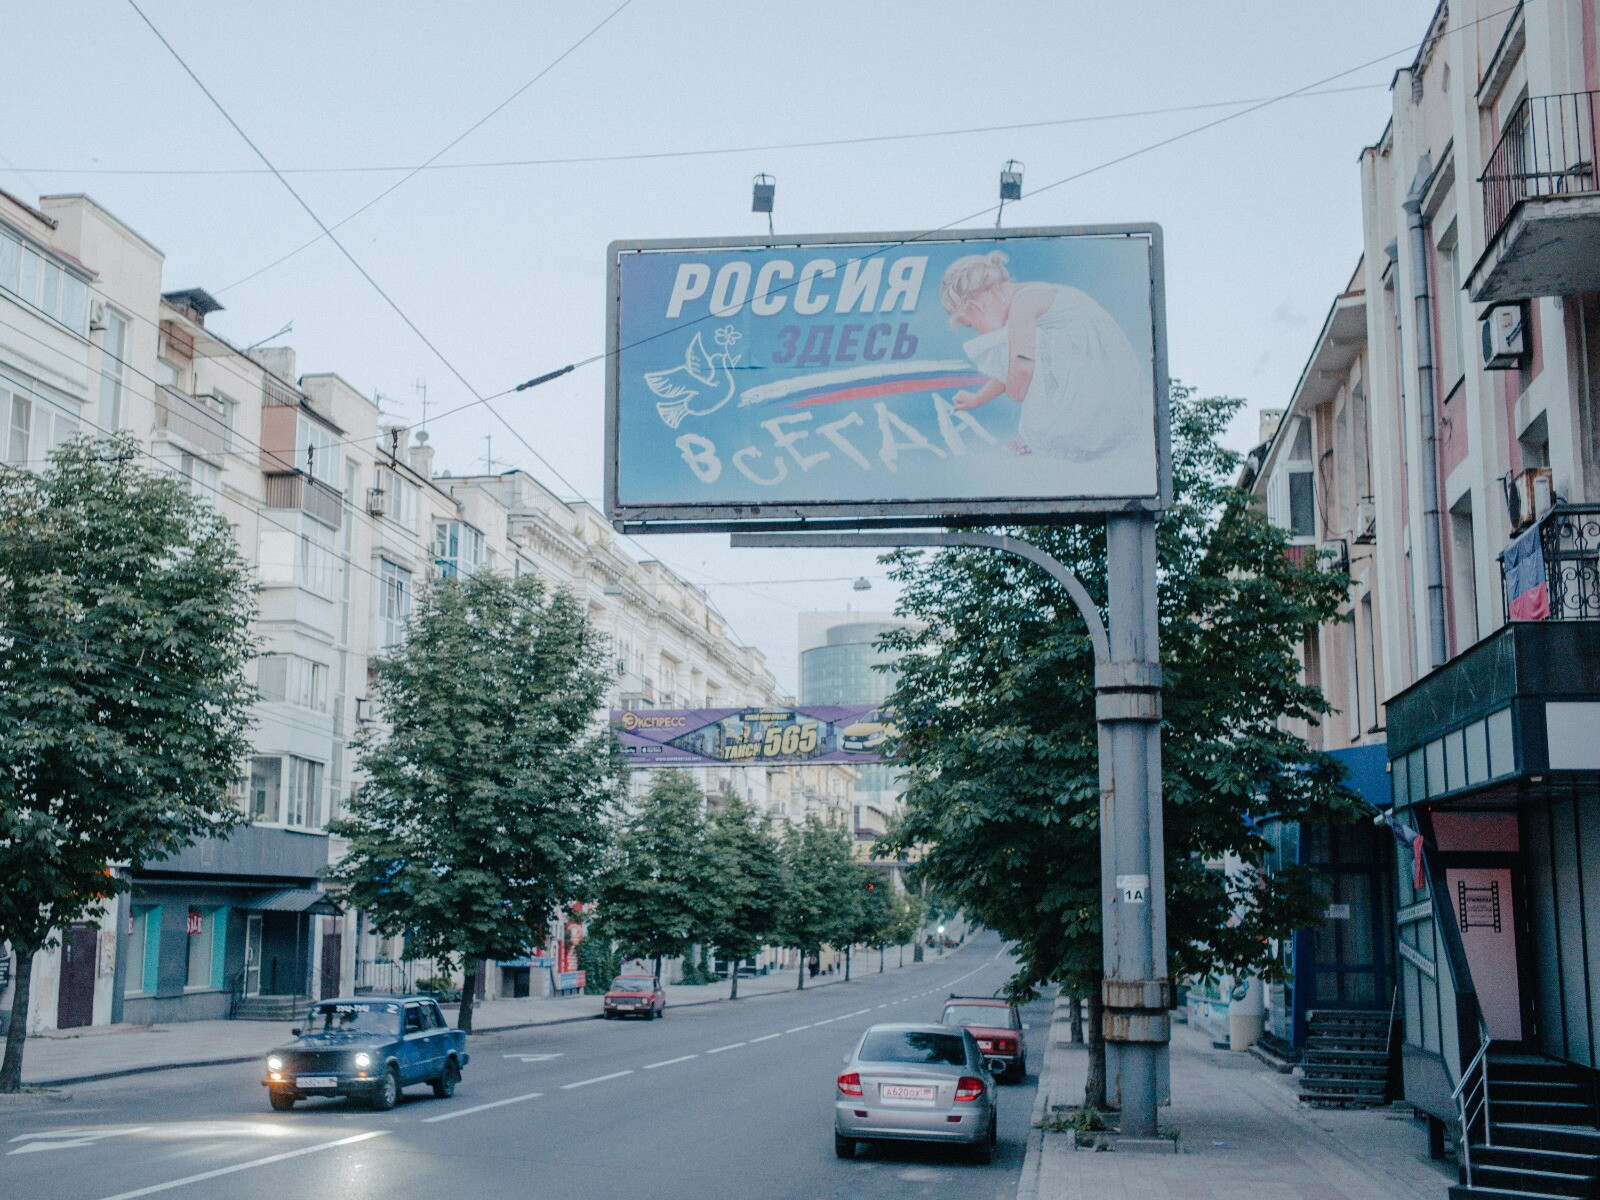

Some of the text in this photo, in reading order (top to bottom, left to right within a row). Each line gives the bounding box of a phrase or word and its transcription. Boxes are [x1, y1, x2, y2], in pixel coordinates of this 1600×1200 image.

[666, 256, 928, 318] РОССИЯ
[772, 323, 918, 366] ЗДЕСЬ
[676, 393, 998, 486] ВСЕГДА
[621, 711, 686, 730] ЭКСПРЕСС
[724, 723, 818, 760] ТАКСИ 565
